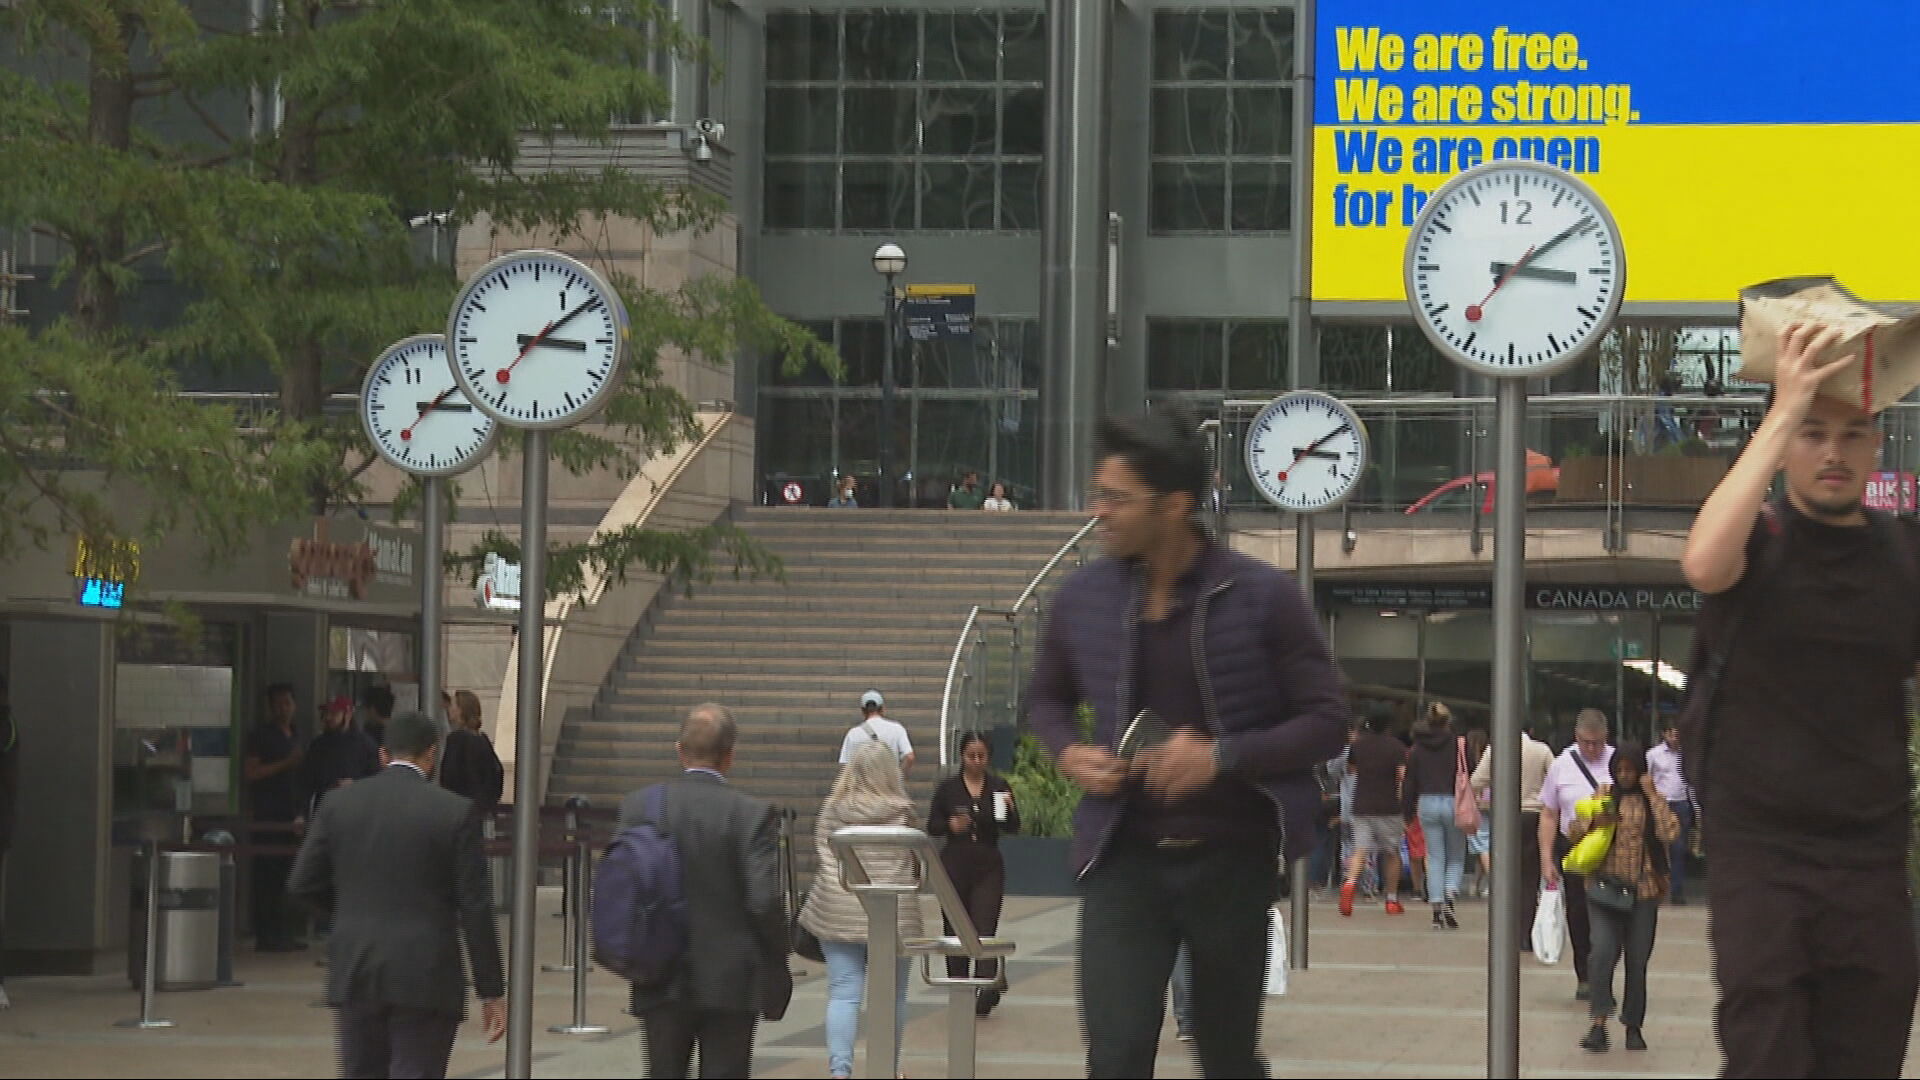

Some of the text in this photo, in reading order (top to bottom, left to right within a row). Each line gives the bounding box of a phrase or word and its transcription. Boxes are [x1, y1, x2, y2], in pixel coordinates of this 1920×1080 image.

[1335, 26, 1588, 71] We are free.
[1334, 78, 1640, 126] We are strong.
[1333, 130, 1403, 174] We
[1412, 137, 1483, 174] are
[1333, 183, 1393, 227] for
[1499, 201, 1533, 225] 12
[1536, 589, 1705, 609] CANADA PLACE
